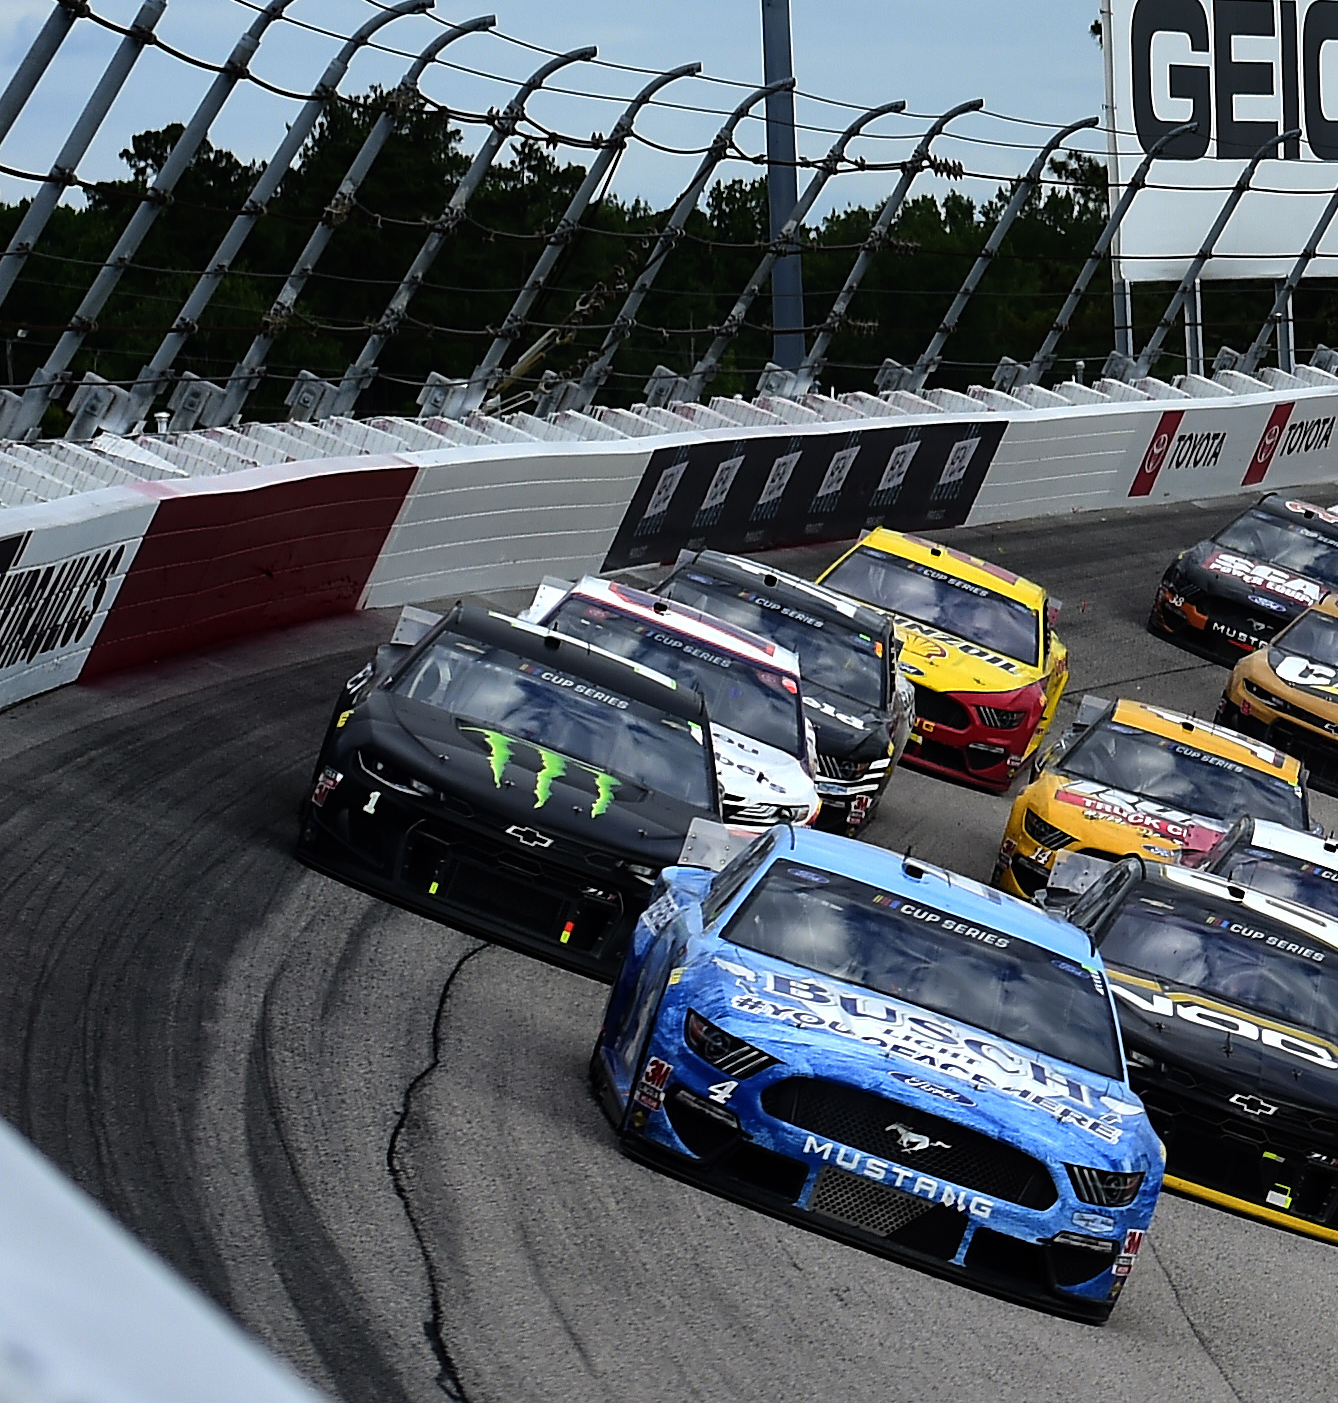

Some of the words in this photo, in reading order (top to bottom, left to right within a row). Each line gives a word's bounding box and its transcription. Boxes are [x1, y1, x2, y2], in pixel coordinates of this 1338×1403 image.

[1168, 432, 1226, 469] TOYOTA
[1280, 417, 1336, 457] TOYOTA
[923, 568, 945, 582] CUP
[946, 573, 989, 598] SERIES
[1216, 553, 1320, 601] SCA
[755, 596, 779, 613] CUP
[779, 604, 825, 629] SERIES
[654, 633, 680, 651] CUP
[680, 642, 732, 669] SERIES
[895, 618, 1019, 675] NZOIL
[541, 670, 577, 693] CUP
[577, 681, 629, 709] SERIES
[1175, 745, 1201, 760] CUP
[1200, 752, 1244, 774] SERIES
[362, 791, 381, 814] 1
[1082, 797, 1161, 830] TRUCK
[1030, 847, 1052, 865] 14
[900, 902, 942, 926] CUP
[940, 915, 1010, 949] SERIES
[1229, 922, 1265, 942] CUP
[1265, 934, 1325, 963] SERIES
[773, 973, 1086, 1104] BUSCH
[884, 1028, 981, 1065] LIGHT
[644, 1059, 671, 1090] 3M
[708, 1080, 739, 1104] 4
[903, 1075, 961, 1102] Ford
[803, 1135, 994, 1219] MUSTANG
